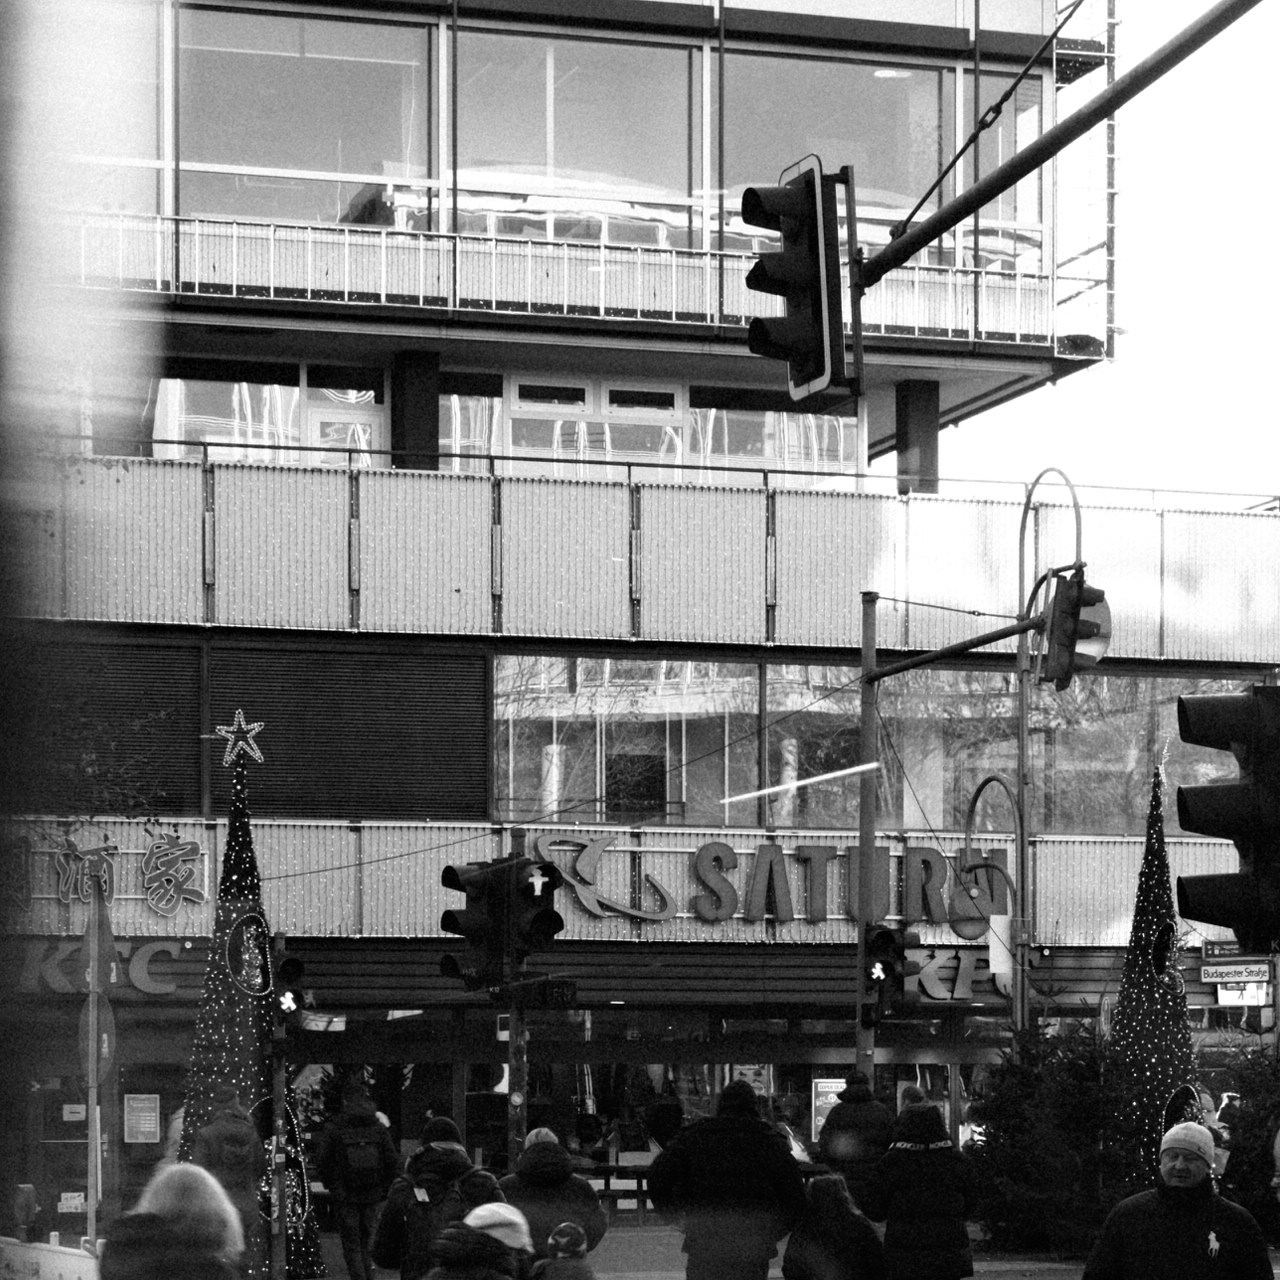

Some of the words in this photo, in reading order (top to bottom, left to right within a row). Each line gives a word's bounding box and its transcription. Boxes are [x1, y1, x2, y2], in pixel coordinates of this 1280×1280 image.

[689, 841, 1009, 924] SATURN
[1203, 968, 1244, 982] Budapester
[1244, 967, 1268, 982] Straße
